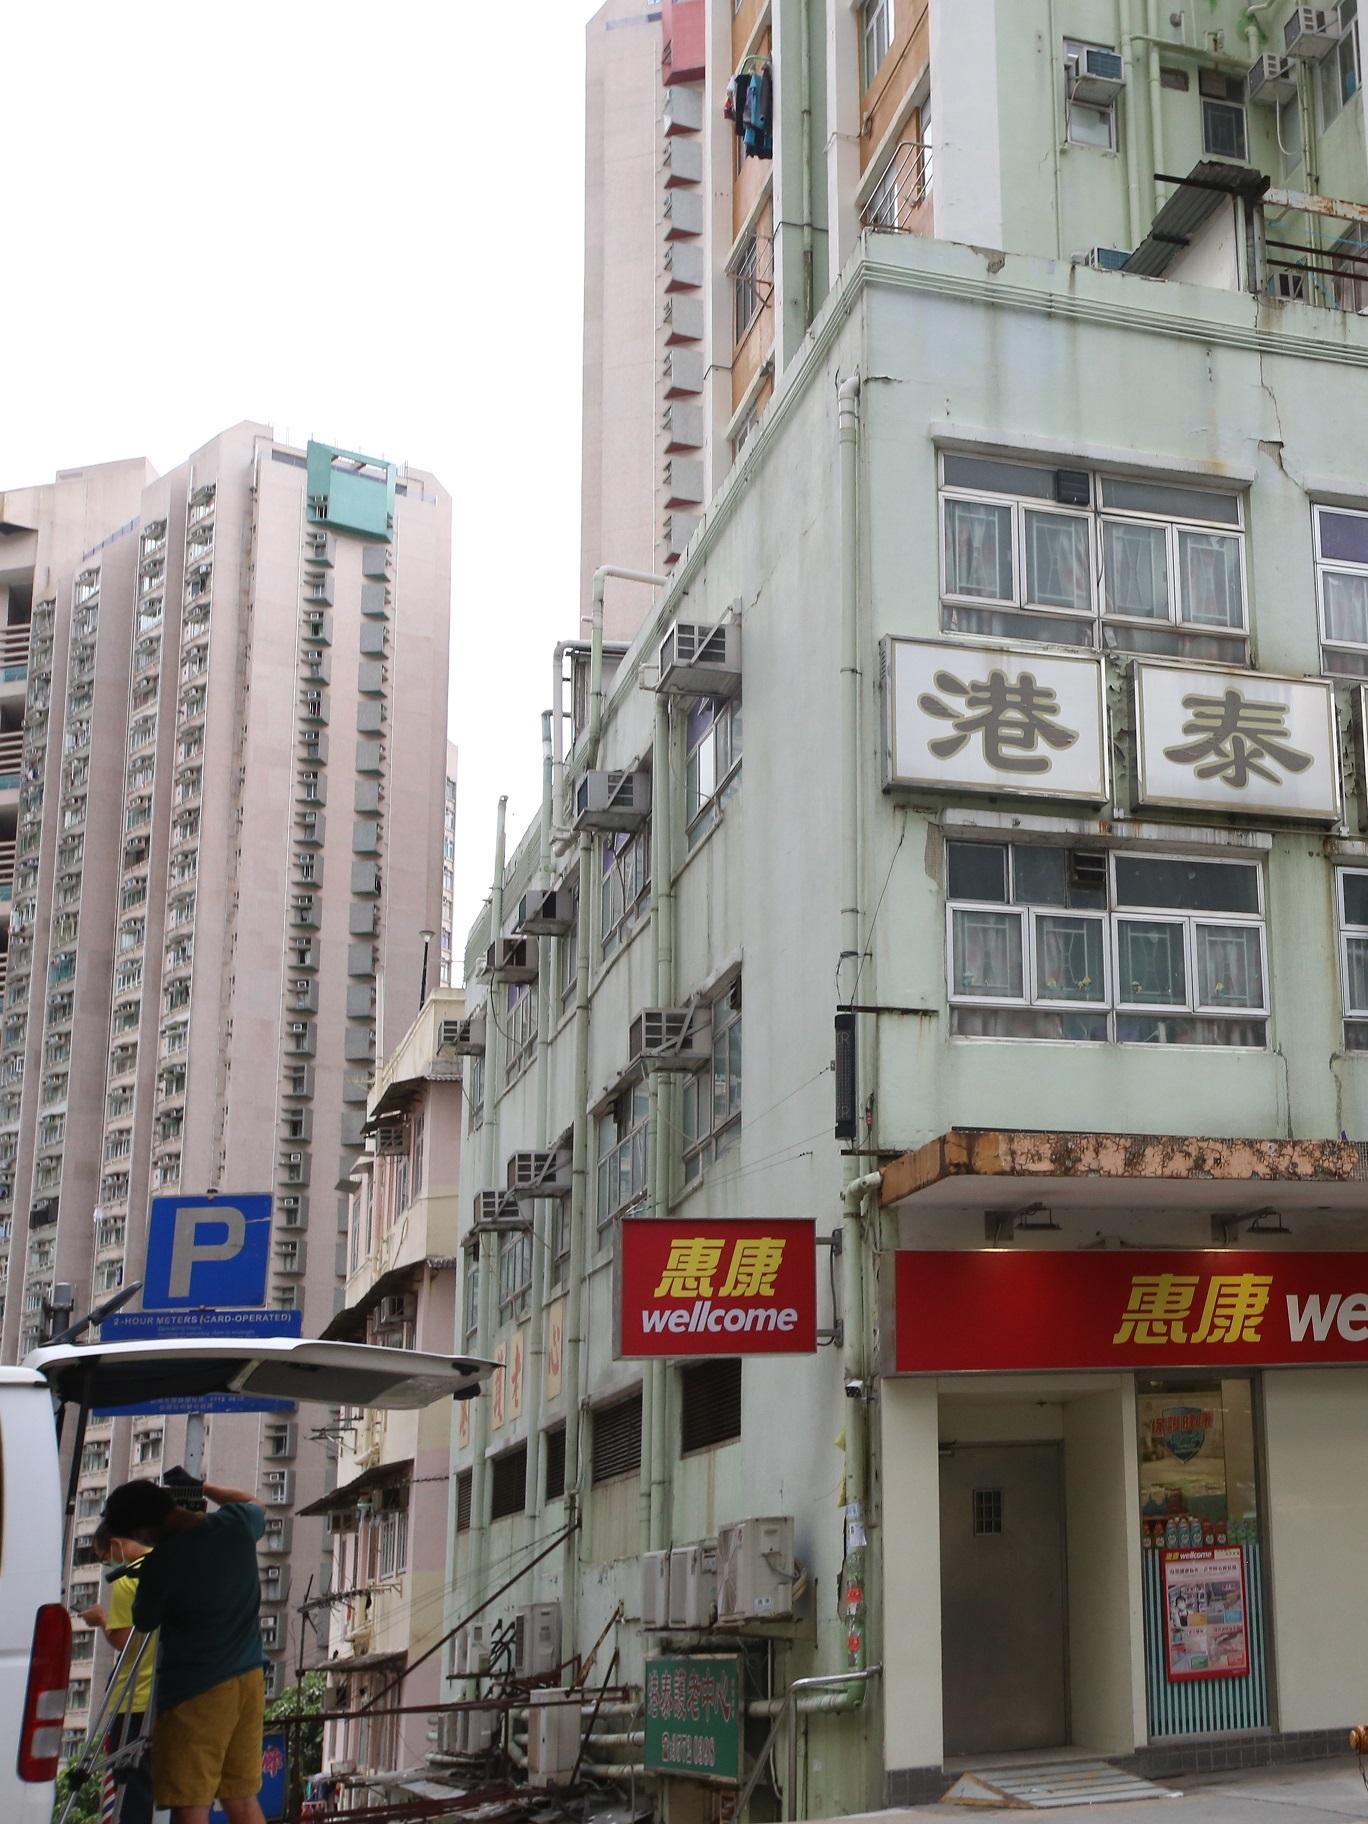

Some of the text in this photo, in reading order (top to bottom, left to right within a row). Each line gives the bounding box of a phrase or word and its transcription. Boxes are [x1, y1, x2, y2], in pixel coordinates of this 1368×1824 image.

[169, 1207, 246, 1298] P
[653, 1236, 787, 1298] 惠康
[641, 1300, 798, 1334] wellcome
[1112, 1273, 1273, 1345] 惠康
[1180, 1551, 1212, 1560] wellcome
